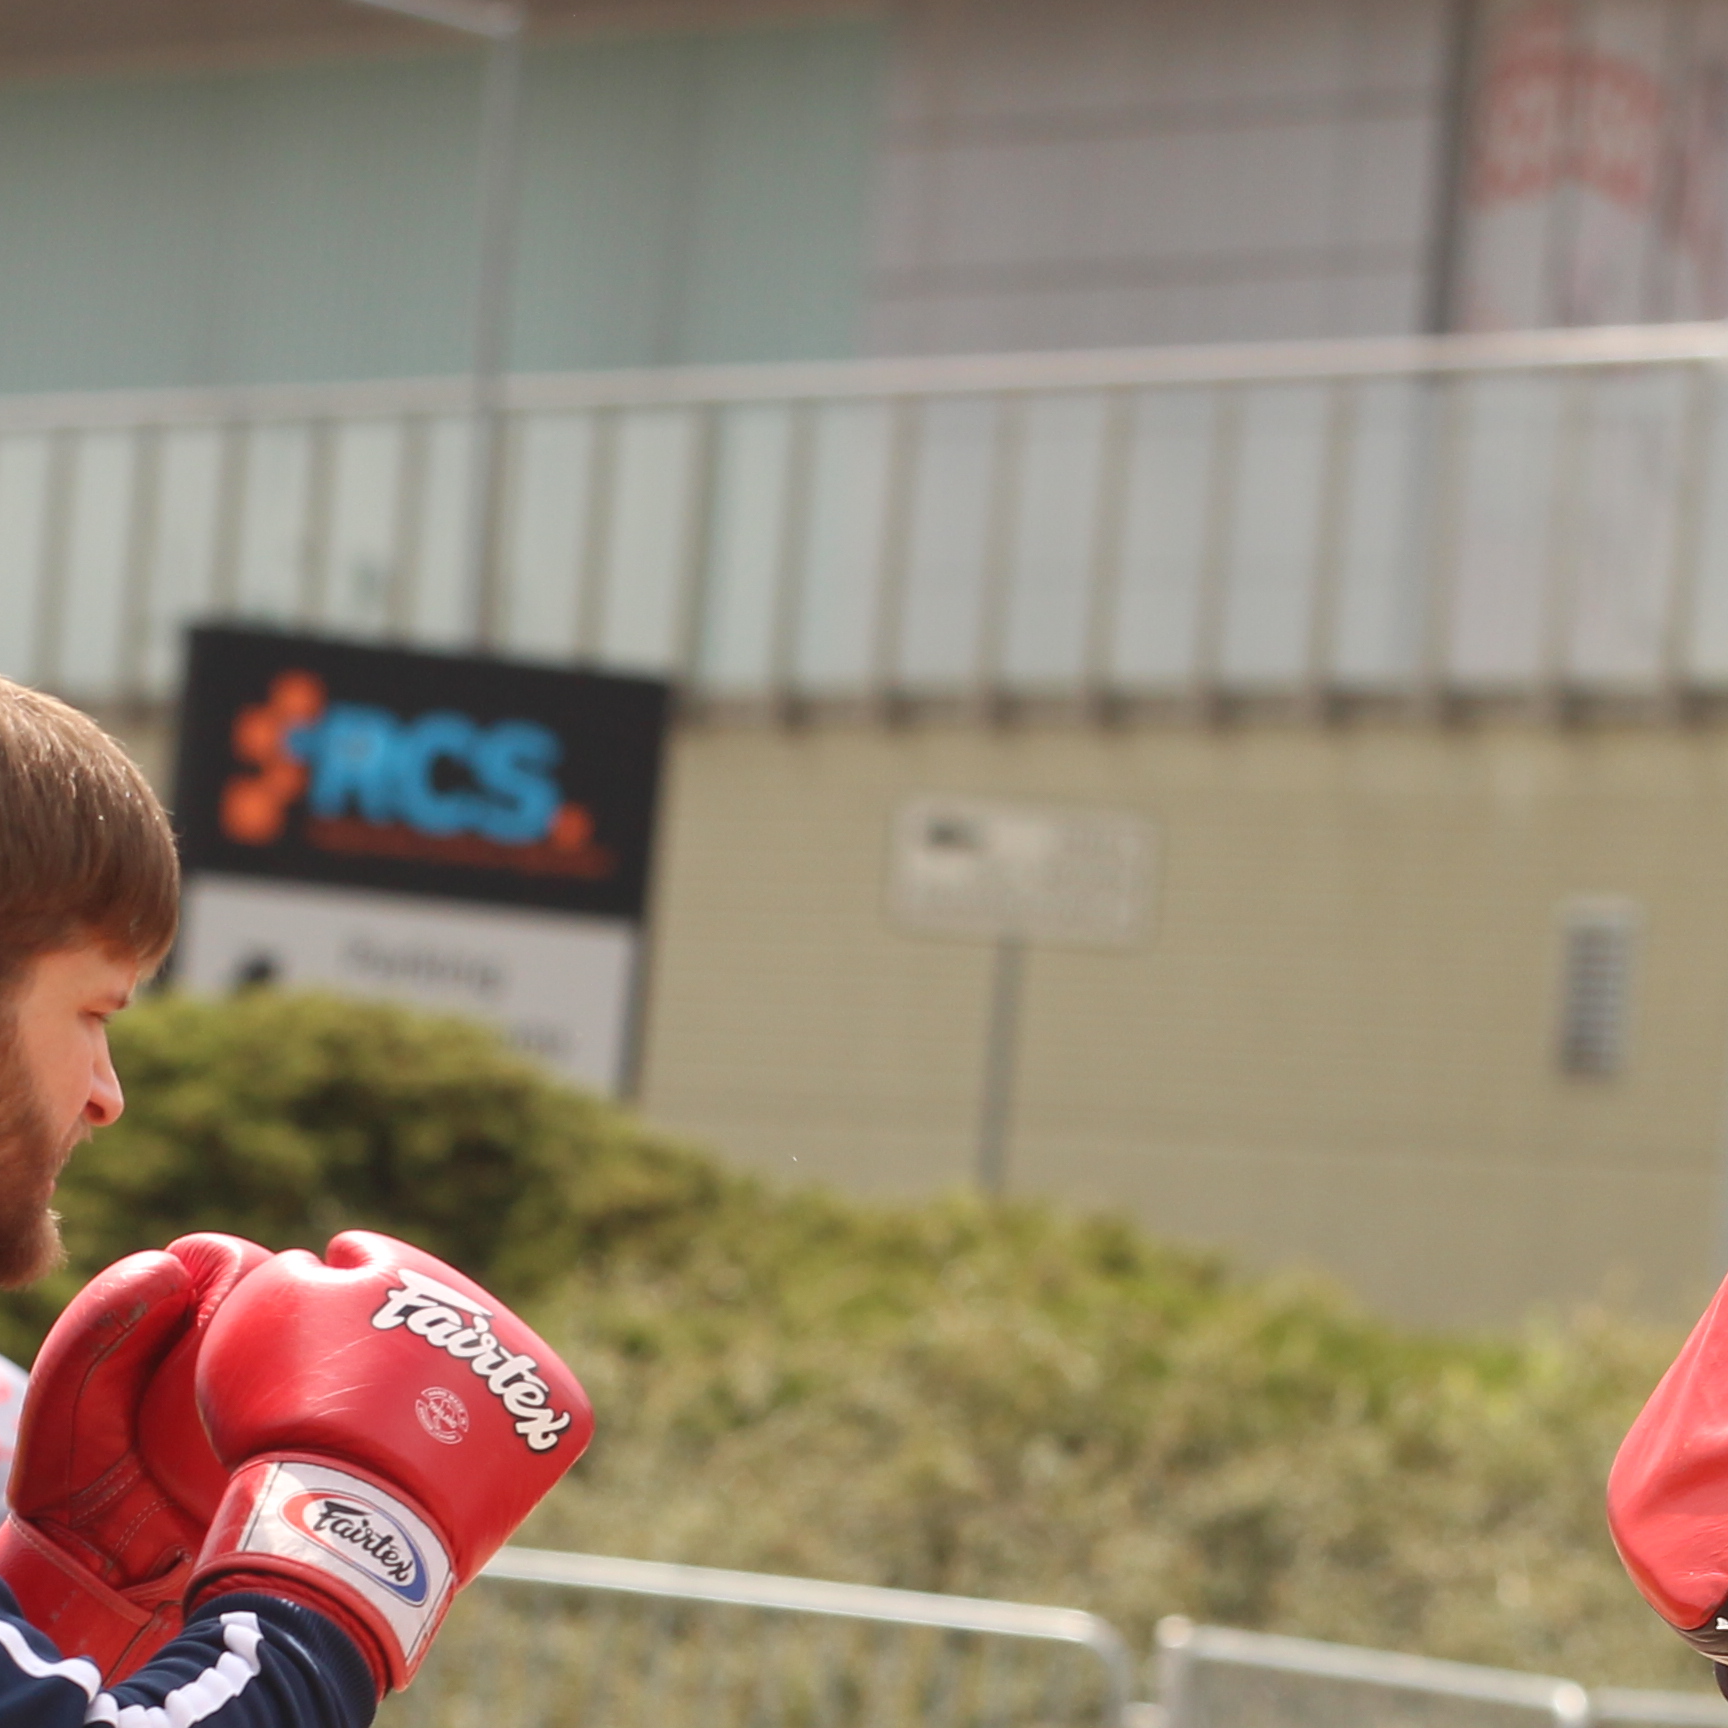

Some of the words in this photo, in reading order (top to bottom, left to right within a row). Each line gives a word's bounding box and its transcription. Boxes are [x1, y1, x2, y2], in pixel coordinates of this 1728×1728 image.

[294, 704, 562, 844] RCS
[371, 1268, 571, 1454] Fairtex
[317, 1499, 419, 1583] Fairtex
